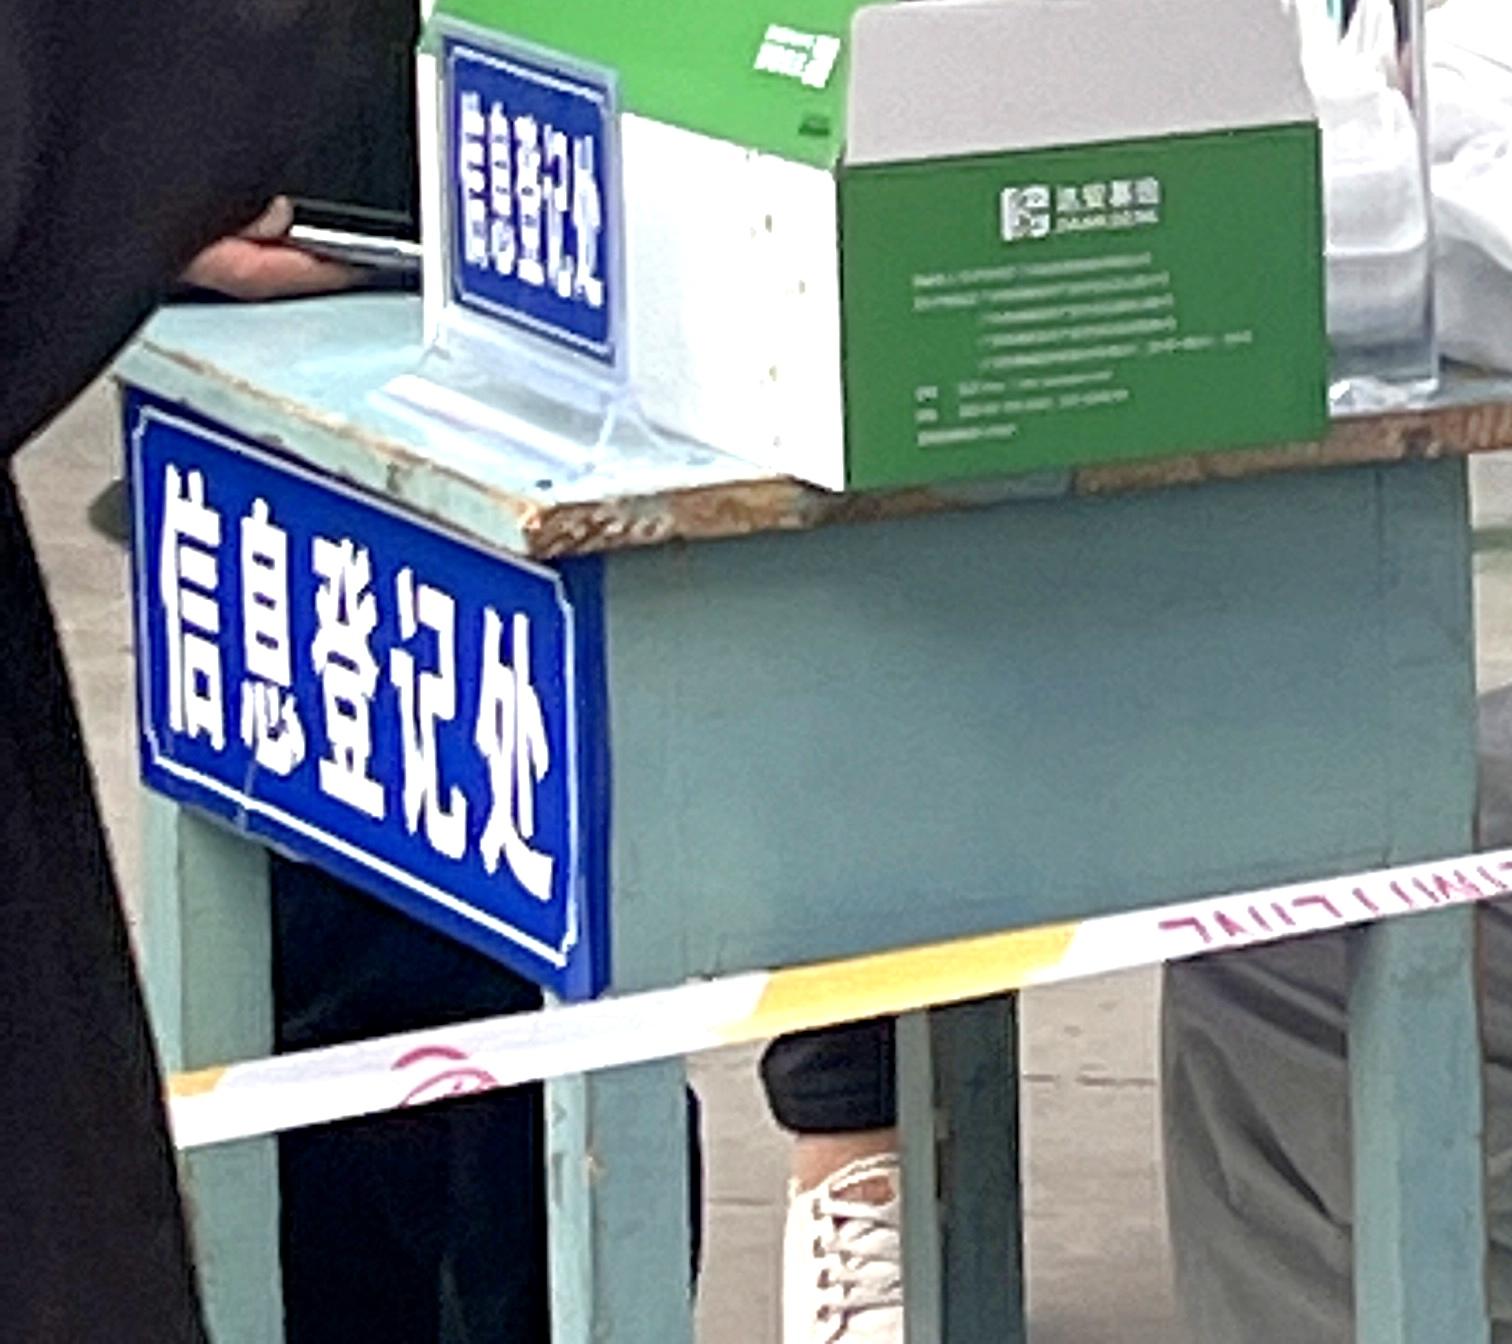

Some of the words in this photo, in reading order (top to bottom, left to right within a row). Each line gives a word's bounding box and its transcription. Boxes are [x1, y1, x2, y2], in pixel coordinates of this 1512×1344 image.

[460, 90, 604, 308] 信息登记处
[161, 464, 554, 902] 信息登记处
